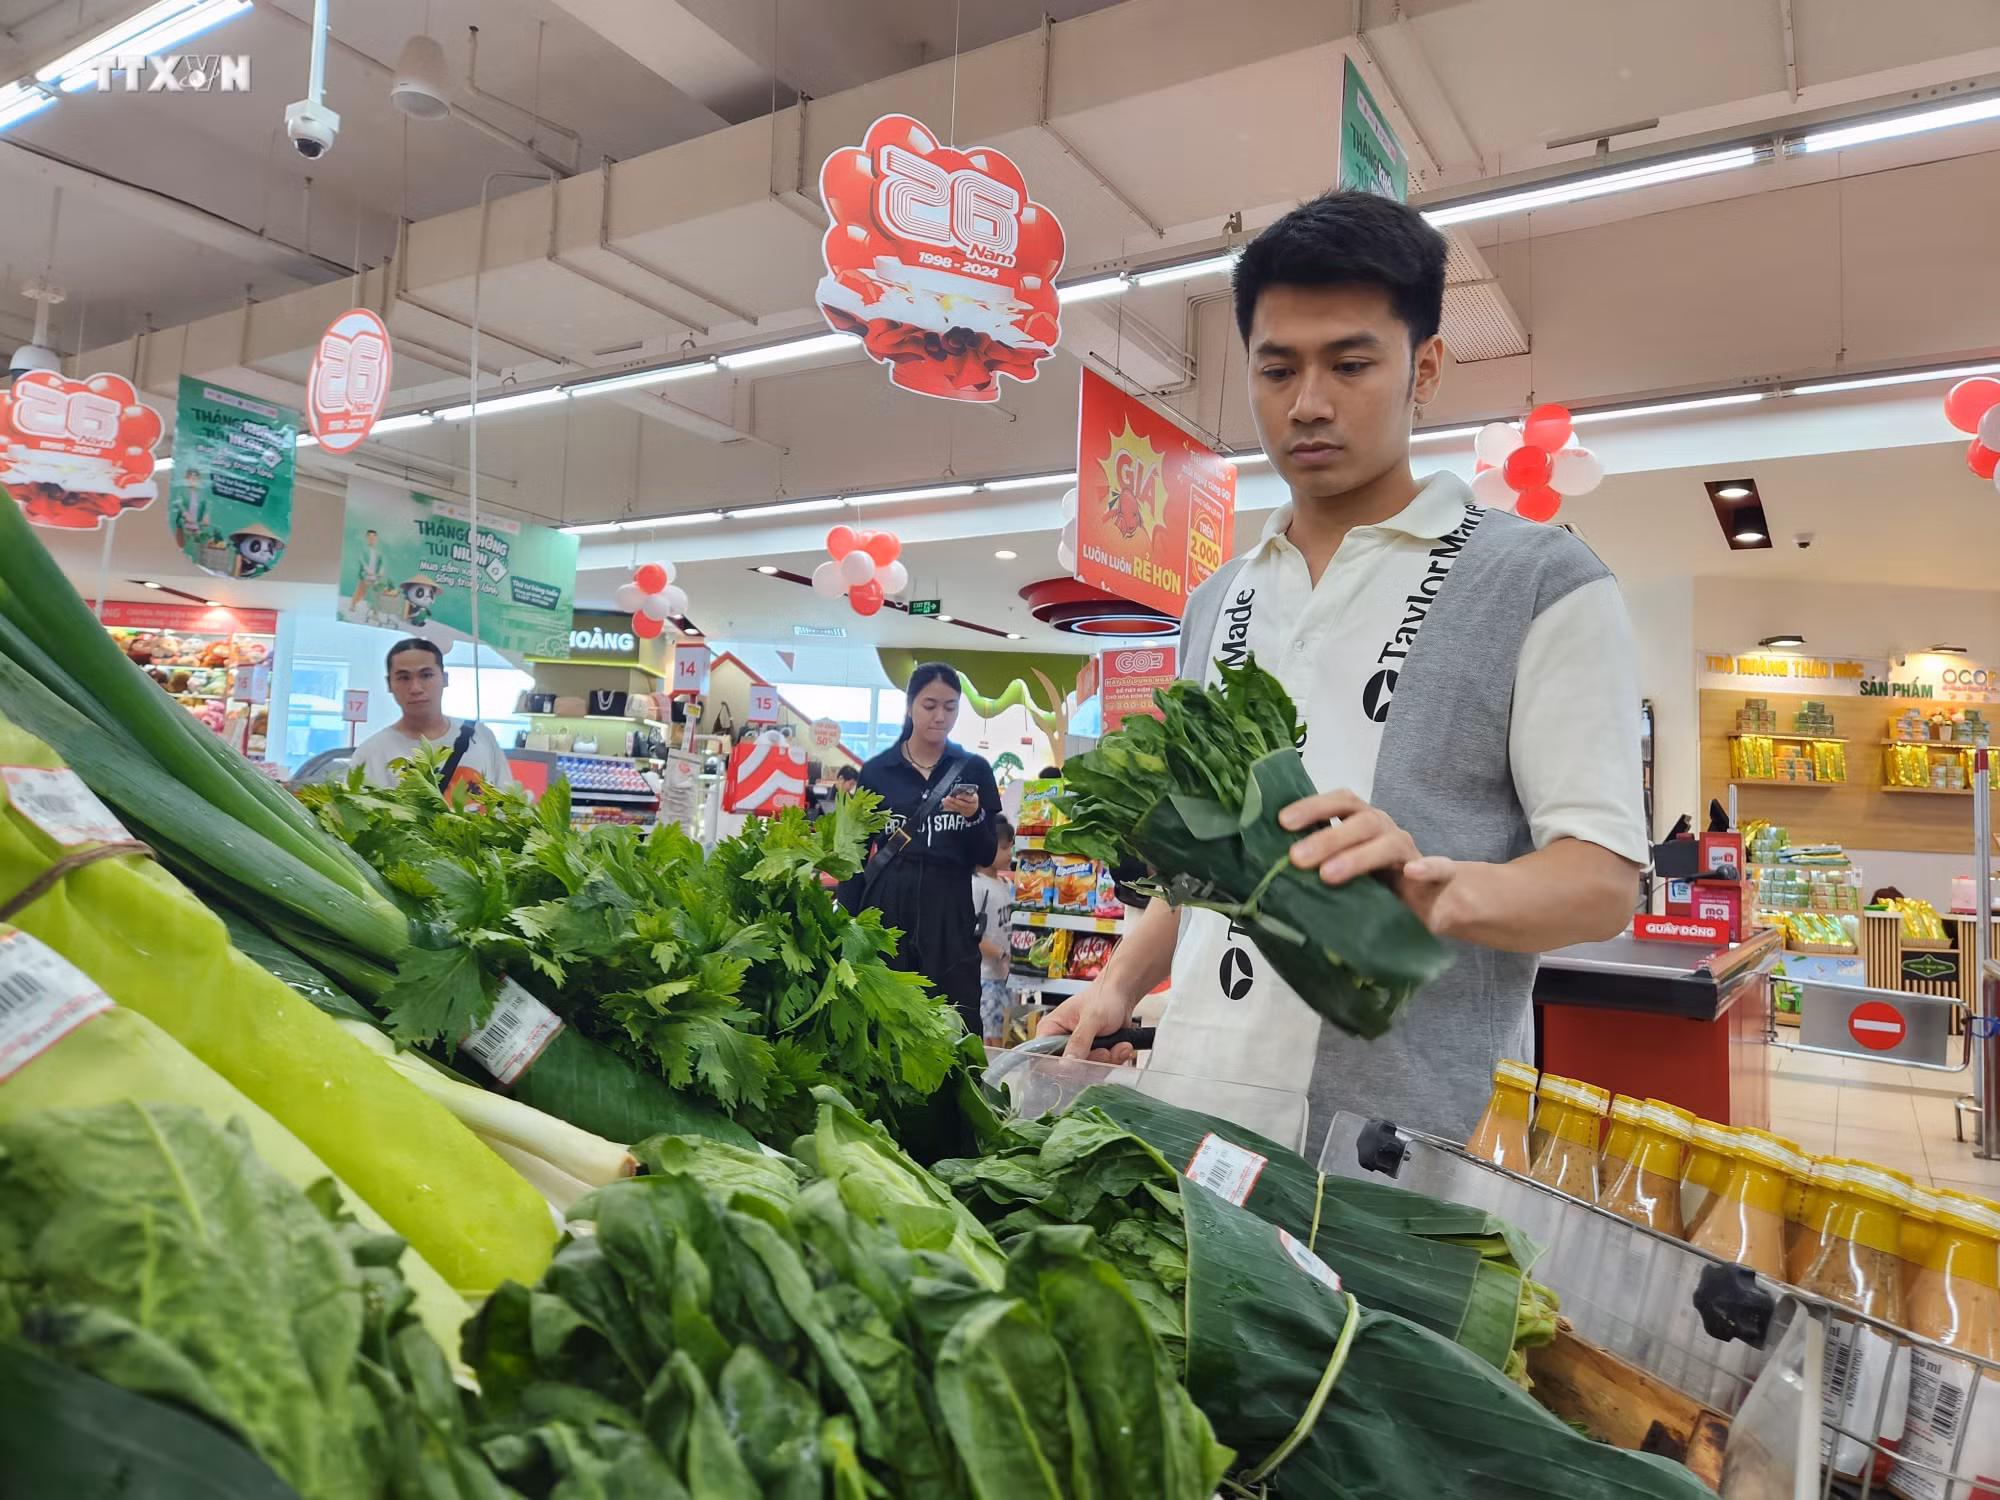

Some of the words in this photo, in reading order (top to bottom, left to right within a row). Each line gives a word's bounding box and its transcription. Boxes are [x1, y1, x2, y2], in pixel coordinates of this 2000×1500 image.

[1350, 122, 1378, 176] THÁNG
[880, 145, 1019, 253] 26
[918, 251, 952, 268] 1998
[961, 261, 999, 279] 2024
[968, 242, 1016, 268] Năm
[316, 334, 384, 413] 26
[13, 381, 121, 440] 26
[191, 408, 241, 430] THÁNG
[414, 519, 465, 541] THÁNG
[425, 541, 449, 557] TÚI
[453, 545, 489, 566] NILN
[1190, 535, 1219, 568] 2.000
[1083, 544, 1108, 566] LUÔN
[1109, 555, 1132, 576] LUÔN
[1133, 552, 1152, 584] RẺ
[1152, 564, 1181, 596] HƠN
[679, 661, 696, 677] 14
[1942, 668, 1998, 689] OCOP
[1860, 675, 1888, 697] SẢN
[349, 701, 364, 712] 17
[755, 697, 773, 711] 15
